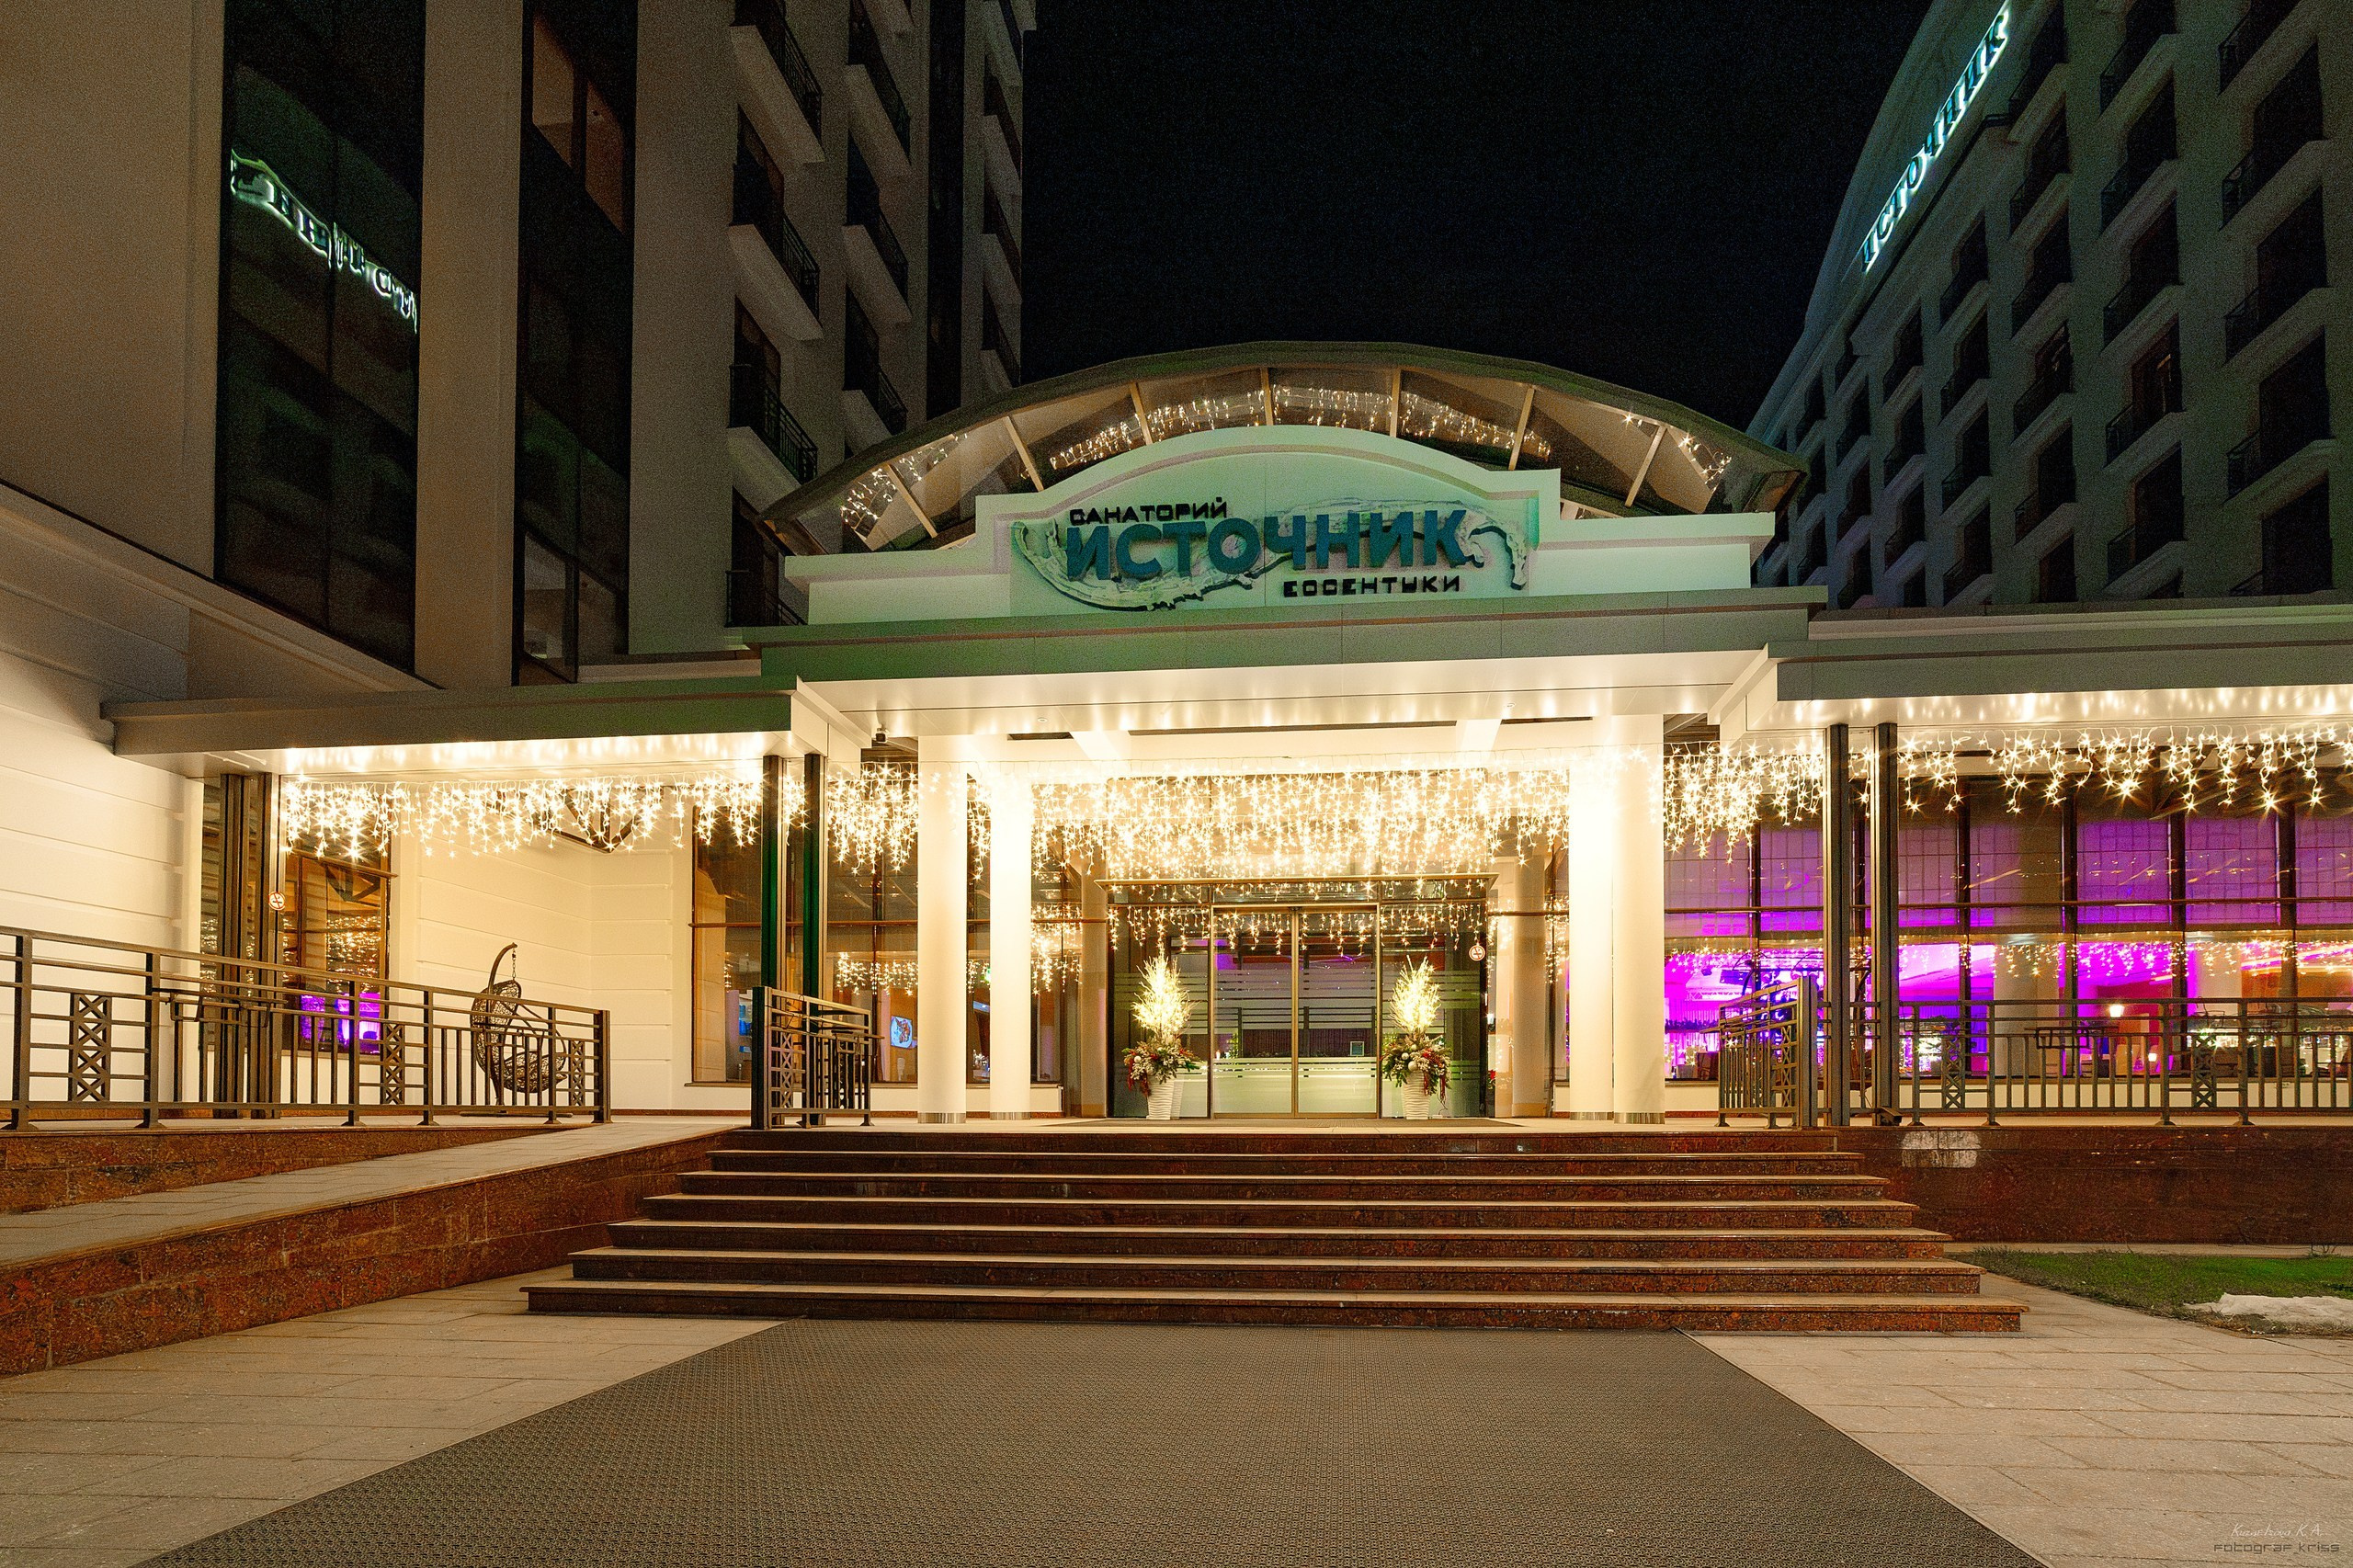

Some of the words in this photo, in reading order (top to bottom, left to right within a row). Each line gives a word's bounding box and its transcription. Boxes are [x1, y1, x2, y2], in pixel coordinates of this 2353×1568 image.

[1069, 496, 1228, 527] САНАТОРИЙ
[1065, 508, 1471, 582] ИСТОЧНИК
[1283, 574, 1461, 597] ЕССЕНТУКИ
